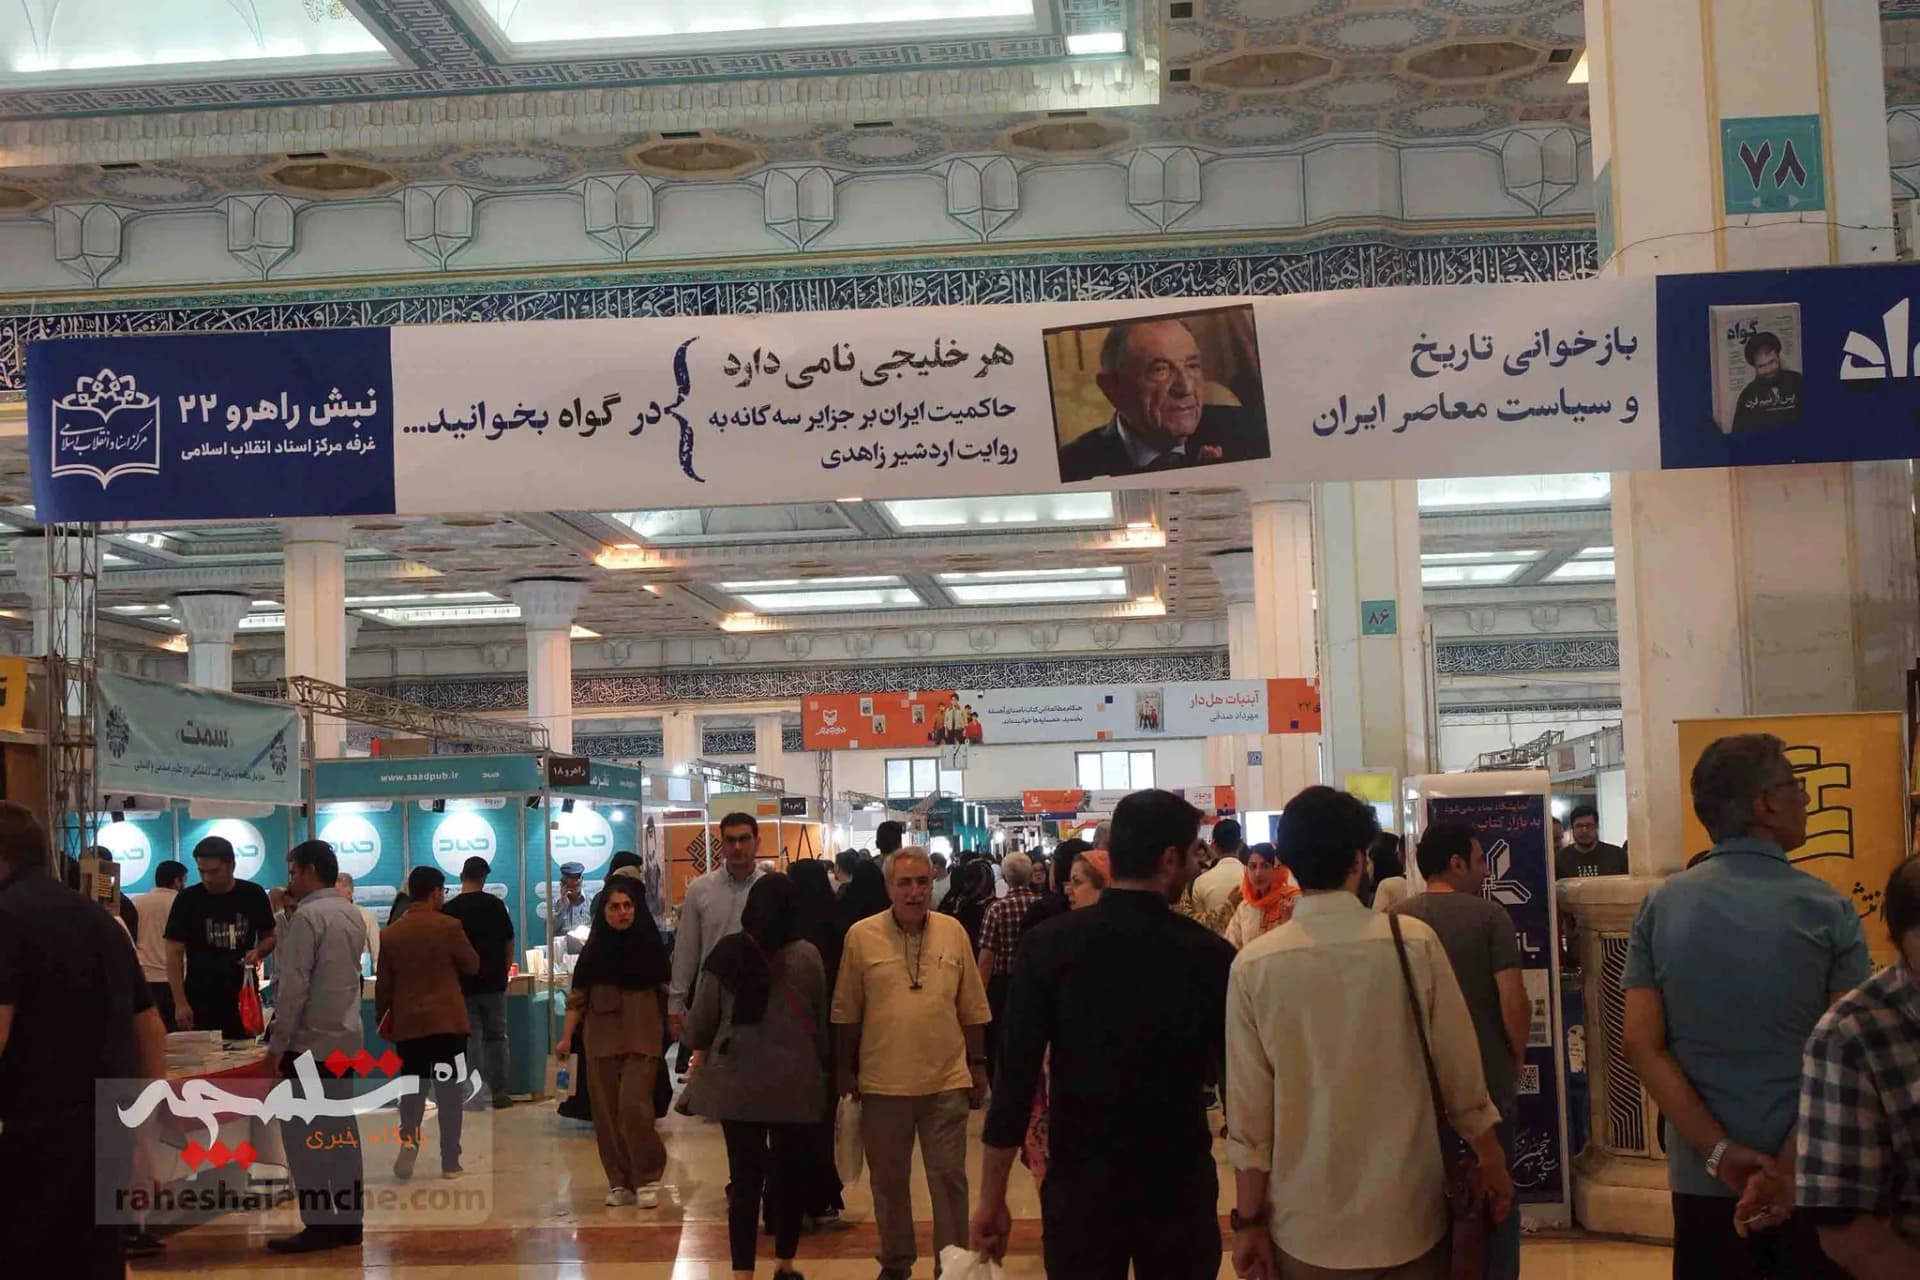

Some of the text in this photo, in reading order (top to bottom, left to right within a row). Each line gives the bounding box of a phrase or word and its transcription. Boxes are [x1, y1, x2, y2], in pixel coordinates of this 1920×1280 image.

[1738, 138, 1807, 191] ۷۸
[723, 337, 1015, 390] هر خلیجی نامی دارد
[1411, 326, 1637, 378] بازخوانی تاریخ
[178, 386, 377, 432] نبش راهرو ۲۲
[558, 393, 622, 438] گواه
[628, 401, 662, 436] در
[709, 412, 727, 432] به
[804, 404, 855, 433] جزایر
[859, 408, 876, 431] بر
[879, 400, 924, 430] ایران
[927, 397, 1016, 422] حاکمیت
[1312, 386, 1640, 437] و سیاست معاصر ایران
[129, 419, 154, 451] مرکز
[180, 433, 376, 460] غرفه مرکز اسناد انقلاب اسلامی
[821, 436, 1018, 469] روایت اردشیر زاهدی
[380, 770, 459, 782] www.saadpub.ir
[553, 766, 586, 777] راهرو ۱۸
